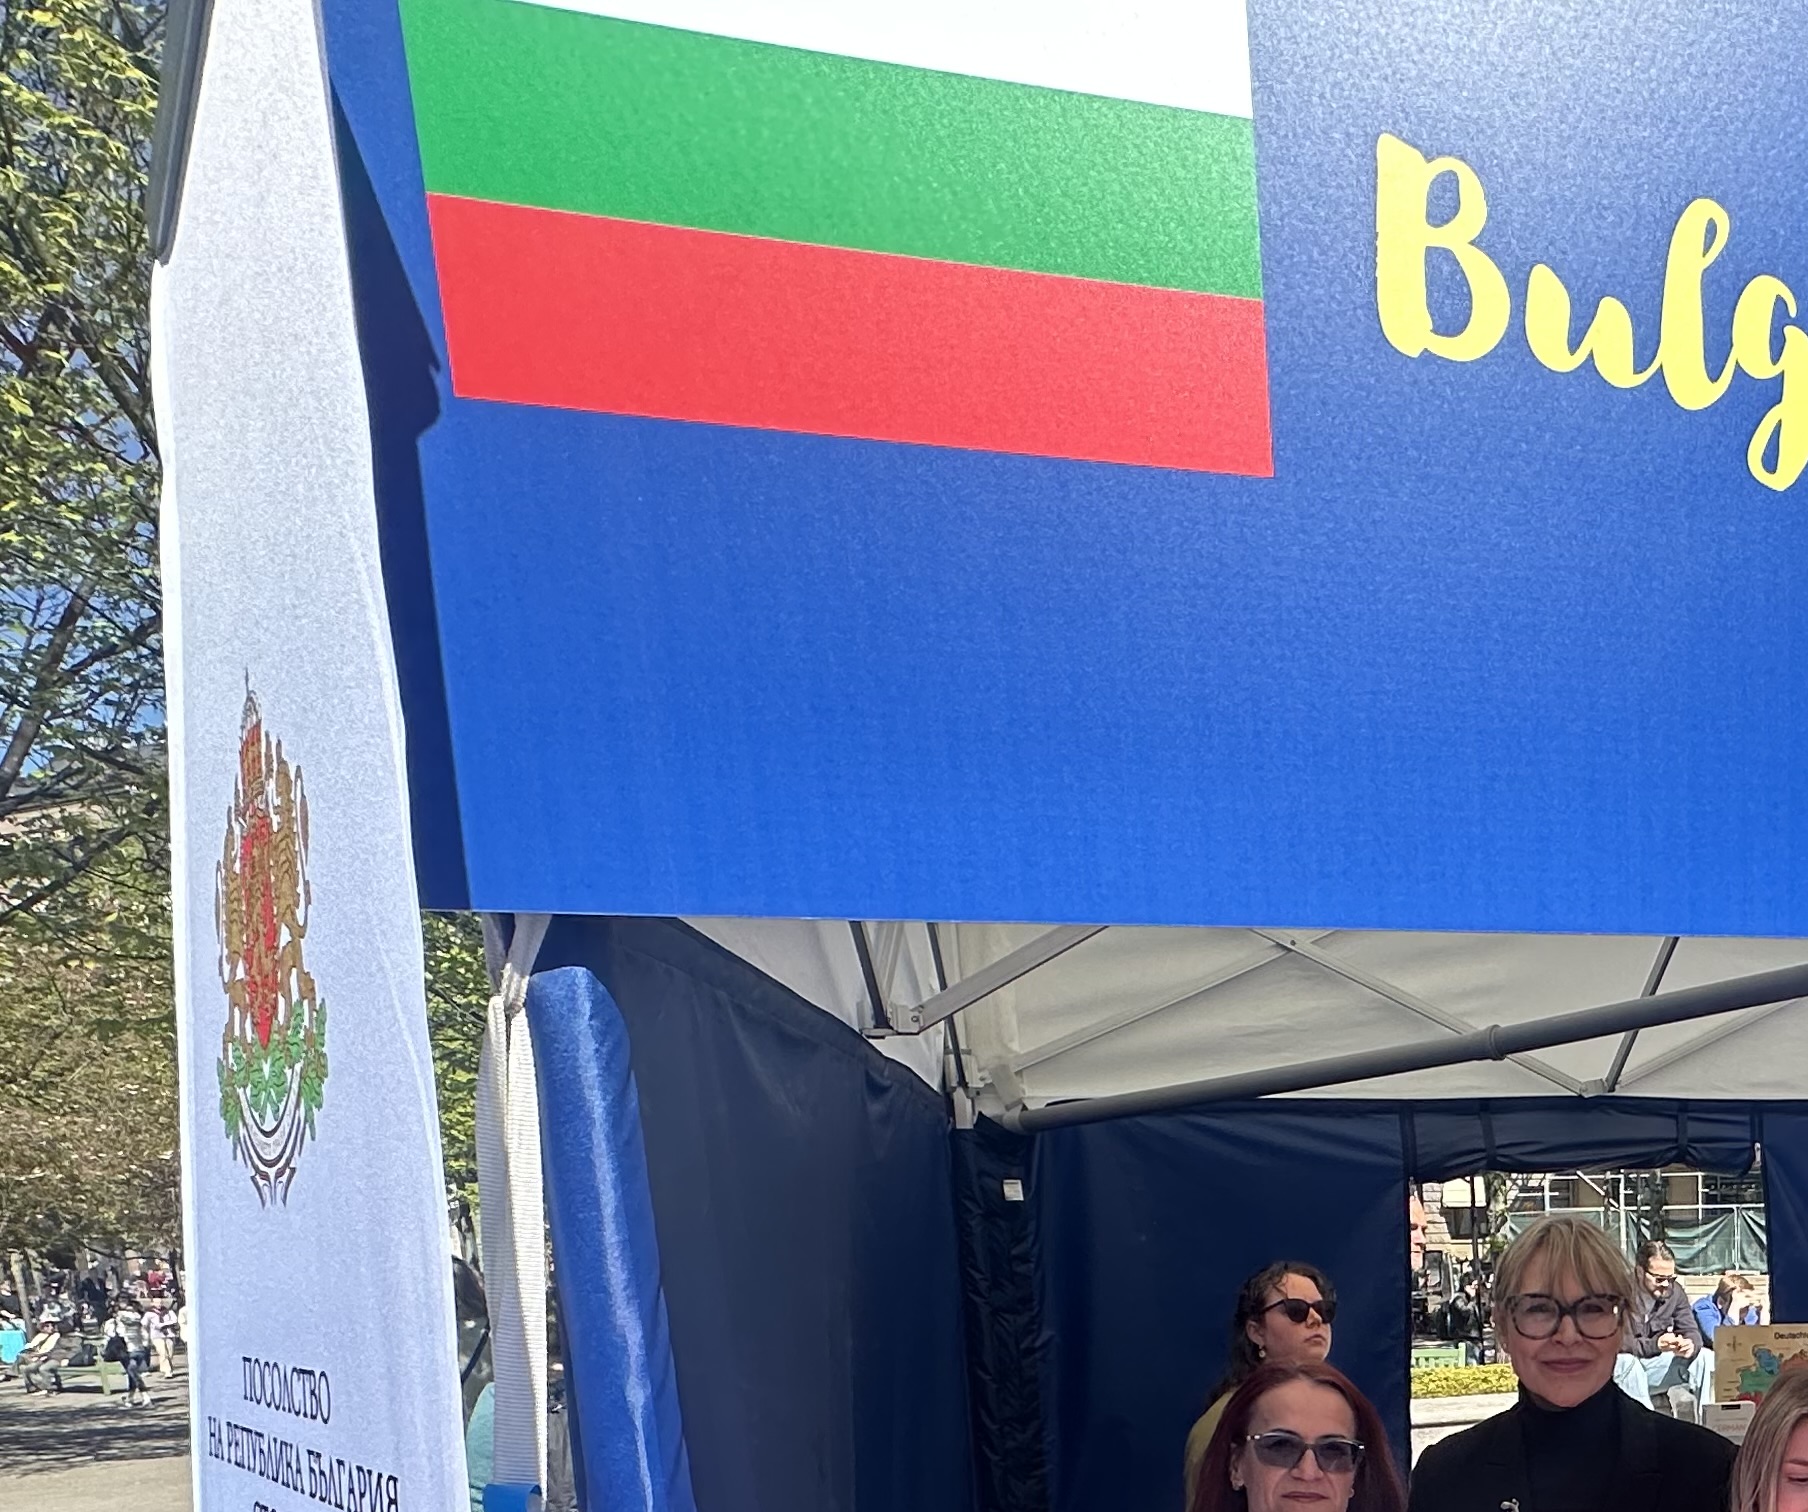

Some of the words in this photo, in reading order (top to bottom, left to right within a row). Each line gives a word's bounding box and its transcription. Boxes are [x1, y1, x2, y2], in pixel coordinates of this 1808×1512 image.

[241, 1356, 332, 1425] ПОСОЛСТВО
[207, 1416, 225, 1462] НА
[225, 1420, 305, 1496] РЕПУБЛИКА
